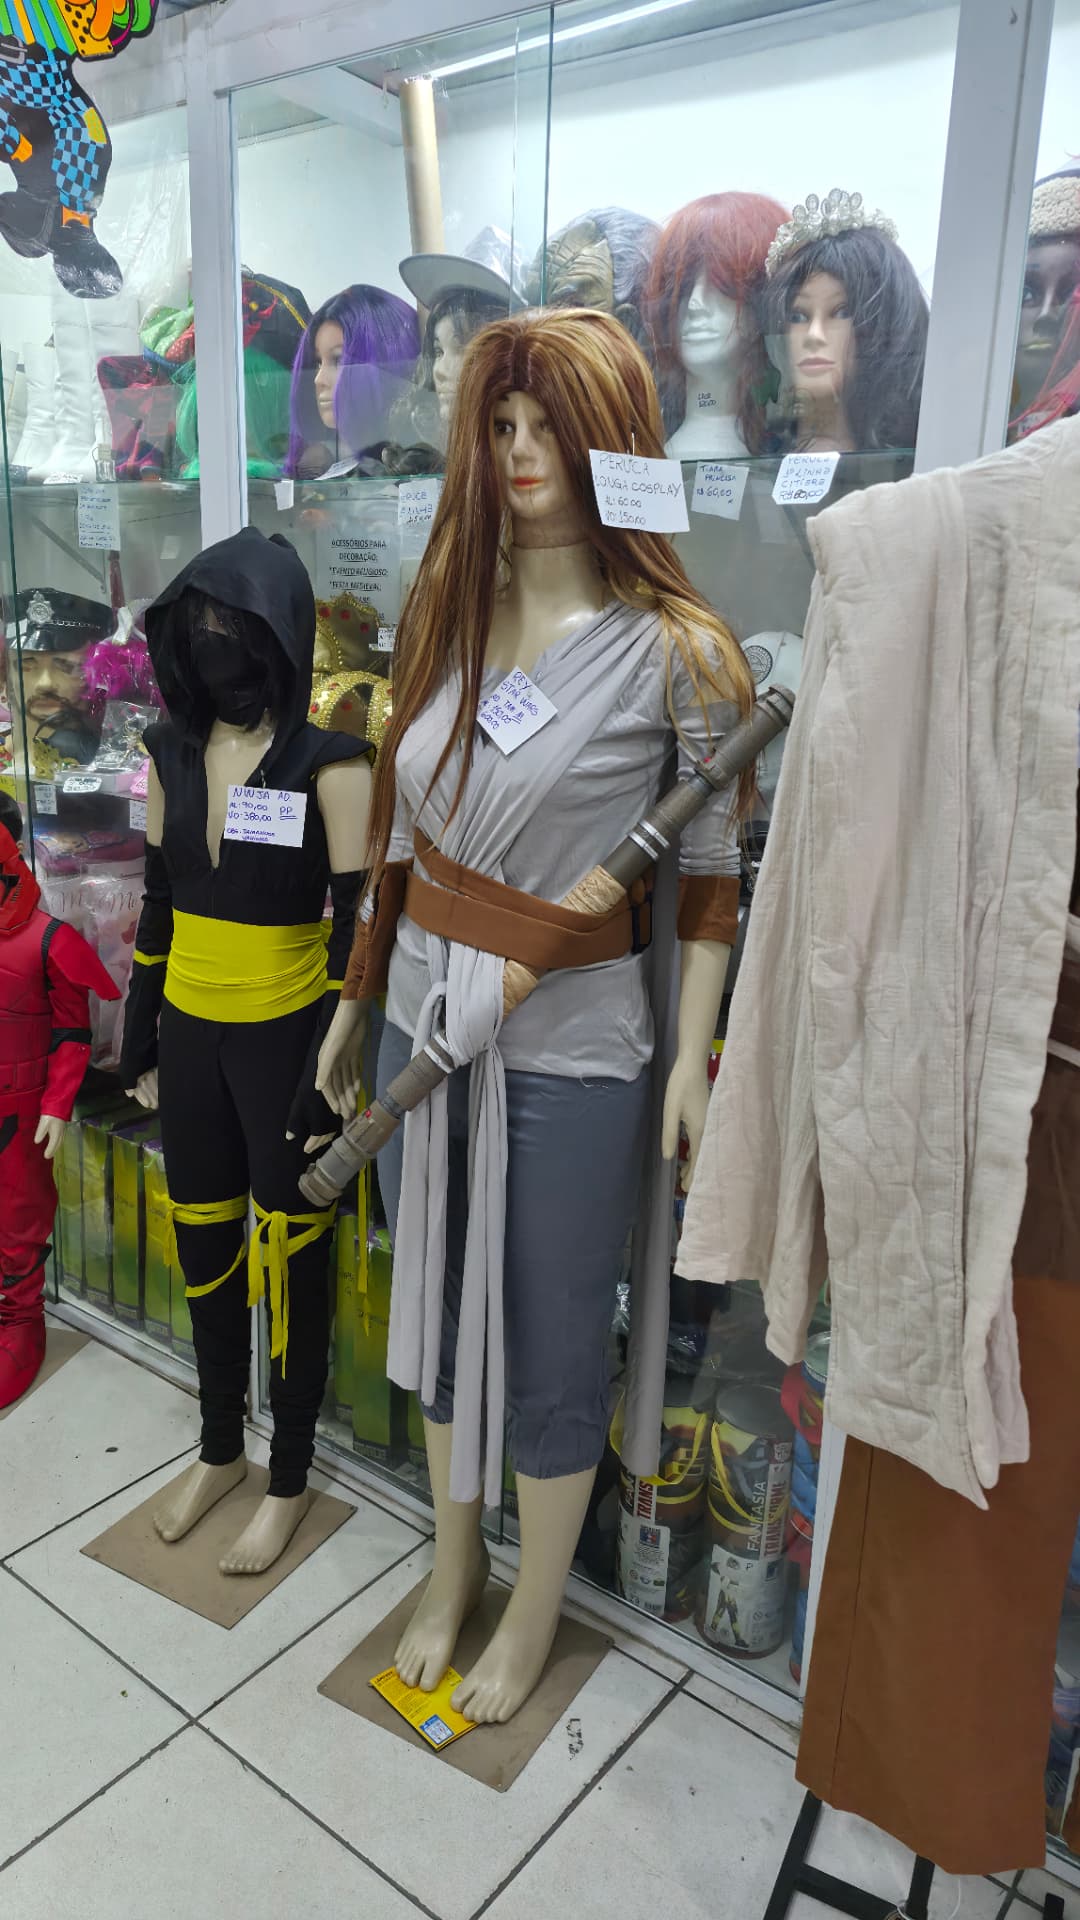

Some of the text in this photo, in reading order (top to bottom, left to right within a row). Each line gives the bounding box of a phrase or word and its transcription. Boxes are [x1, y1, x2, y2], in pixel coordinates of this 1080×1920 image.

[600, 453, 650, 476] PERUCA
[631, 482, 682, 498] COSPLAY
[513, 671, 533, 691] REY
[500, 680, 540, 717] STAR WARS
[279, 805, 293, 816] PP
[747, 1480, 767, 1552] FANTASIA
